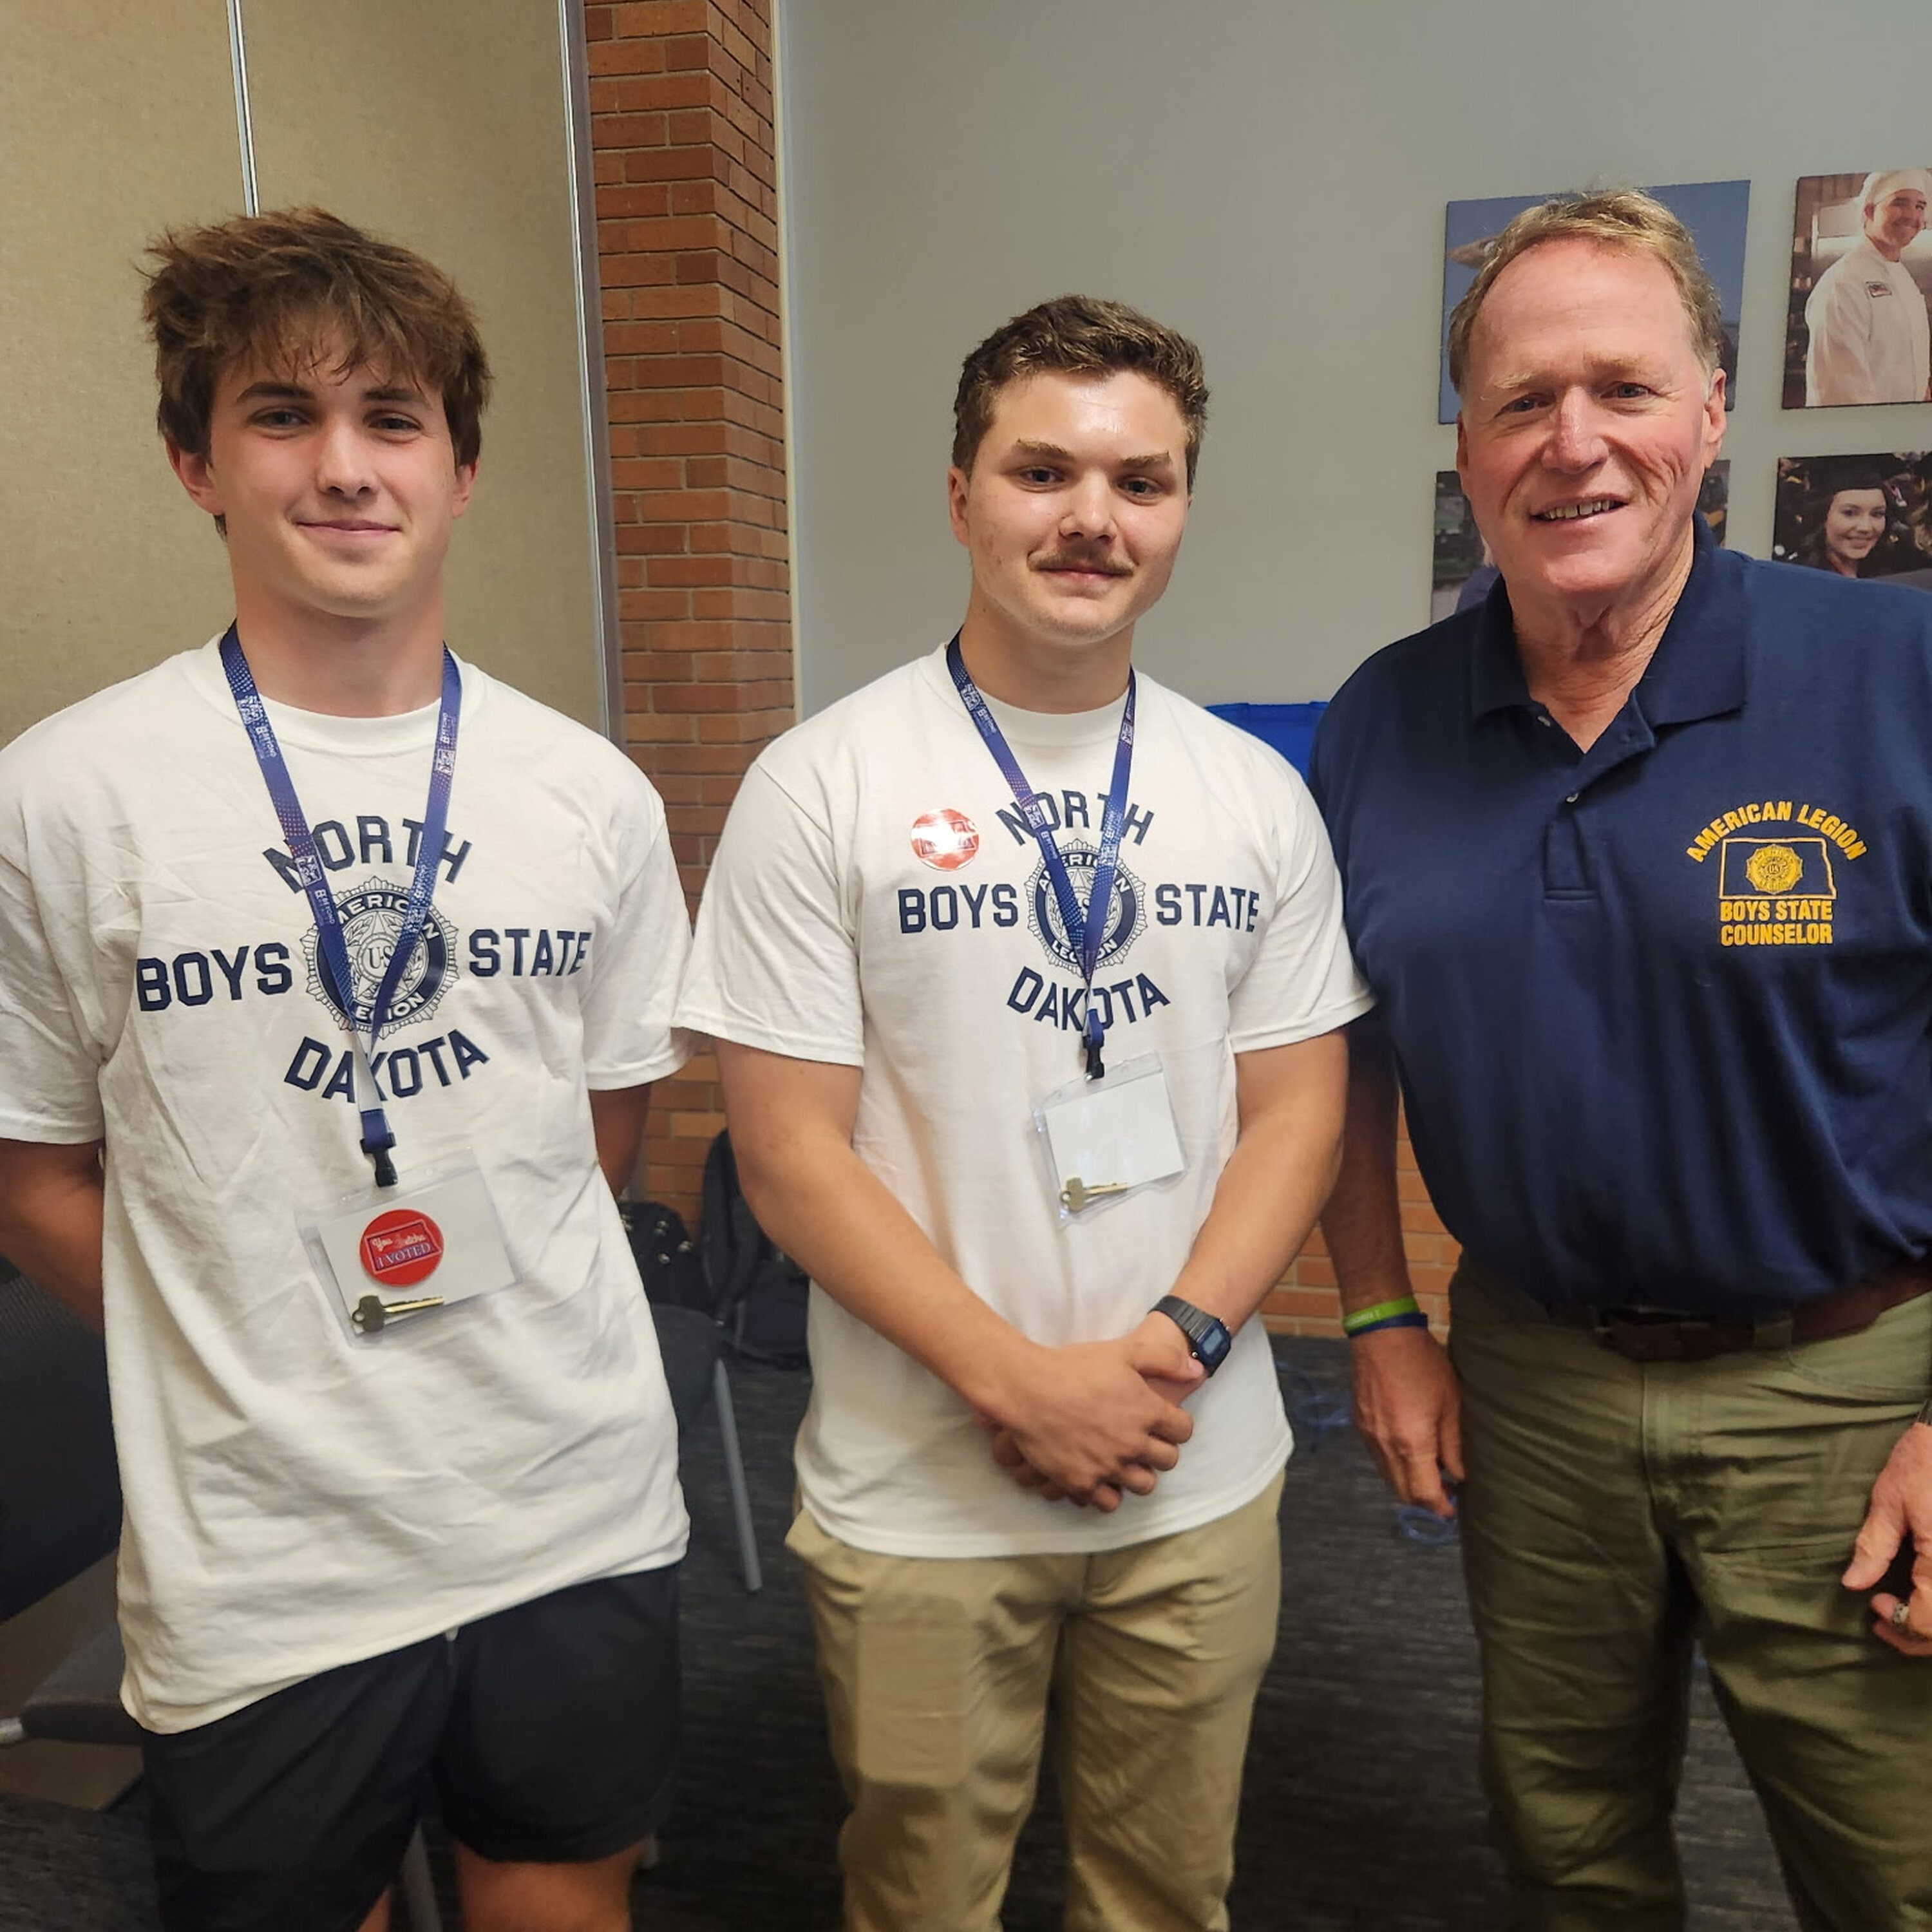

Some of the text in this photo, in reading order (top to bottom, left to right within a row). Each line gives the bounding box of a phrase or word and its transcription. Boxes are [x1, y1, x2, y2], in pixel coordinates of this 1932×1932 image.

[995, 790, 1154, 846] NORTH
[1686, 801, 1868, 863] AMERICAN LEGION
[263, 815, 472, 894] NORTH
[898, 884, 1260, 933] BOYS STATE
[1720, 900, 1833, 922] BOYS STATE
[1720, 923, 1833, 947] COUNSELOR
[136, 929, 592, 1012] BOYS STATE
[1007, 966, 1171, 1032] DAKOTA
[284, 1029, 490, 1103] DAKOTA
[377, 1242, 431, 1268] I VOTED
